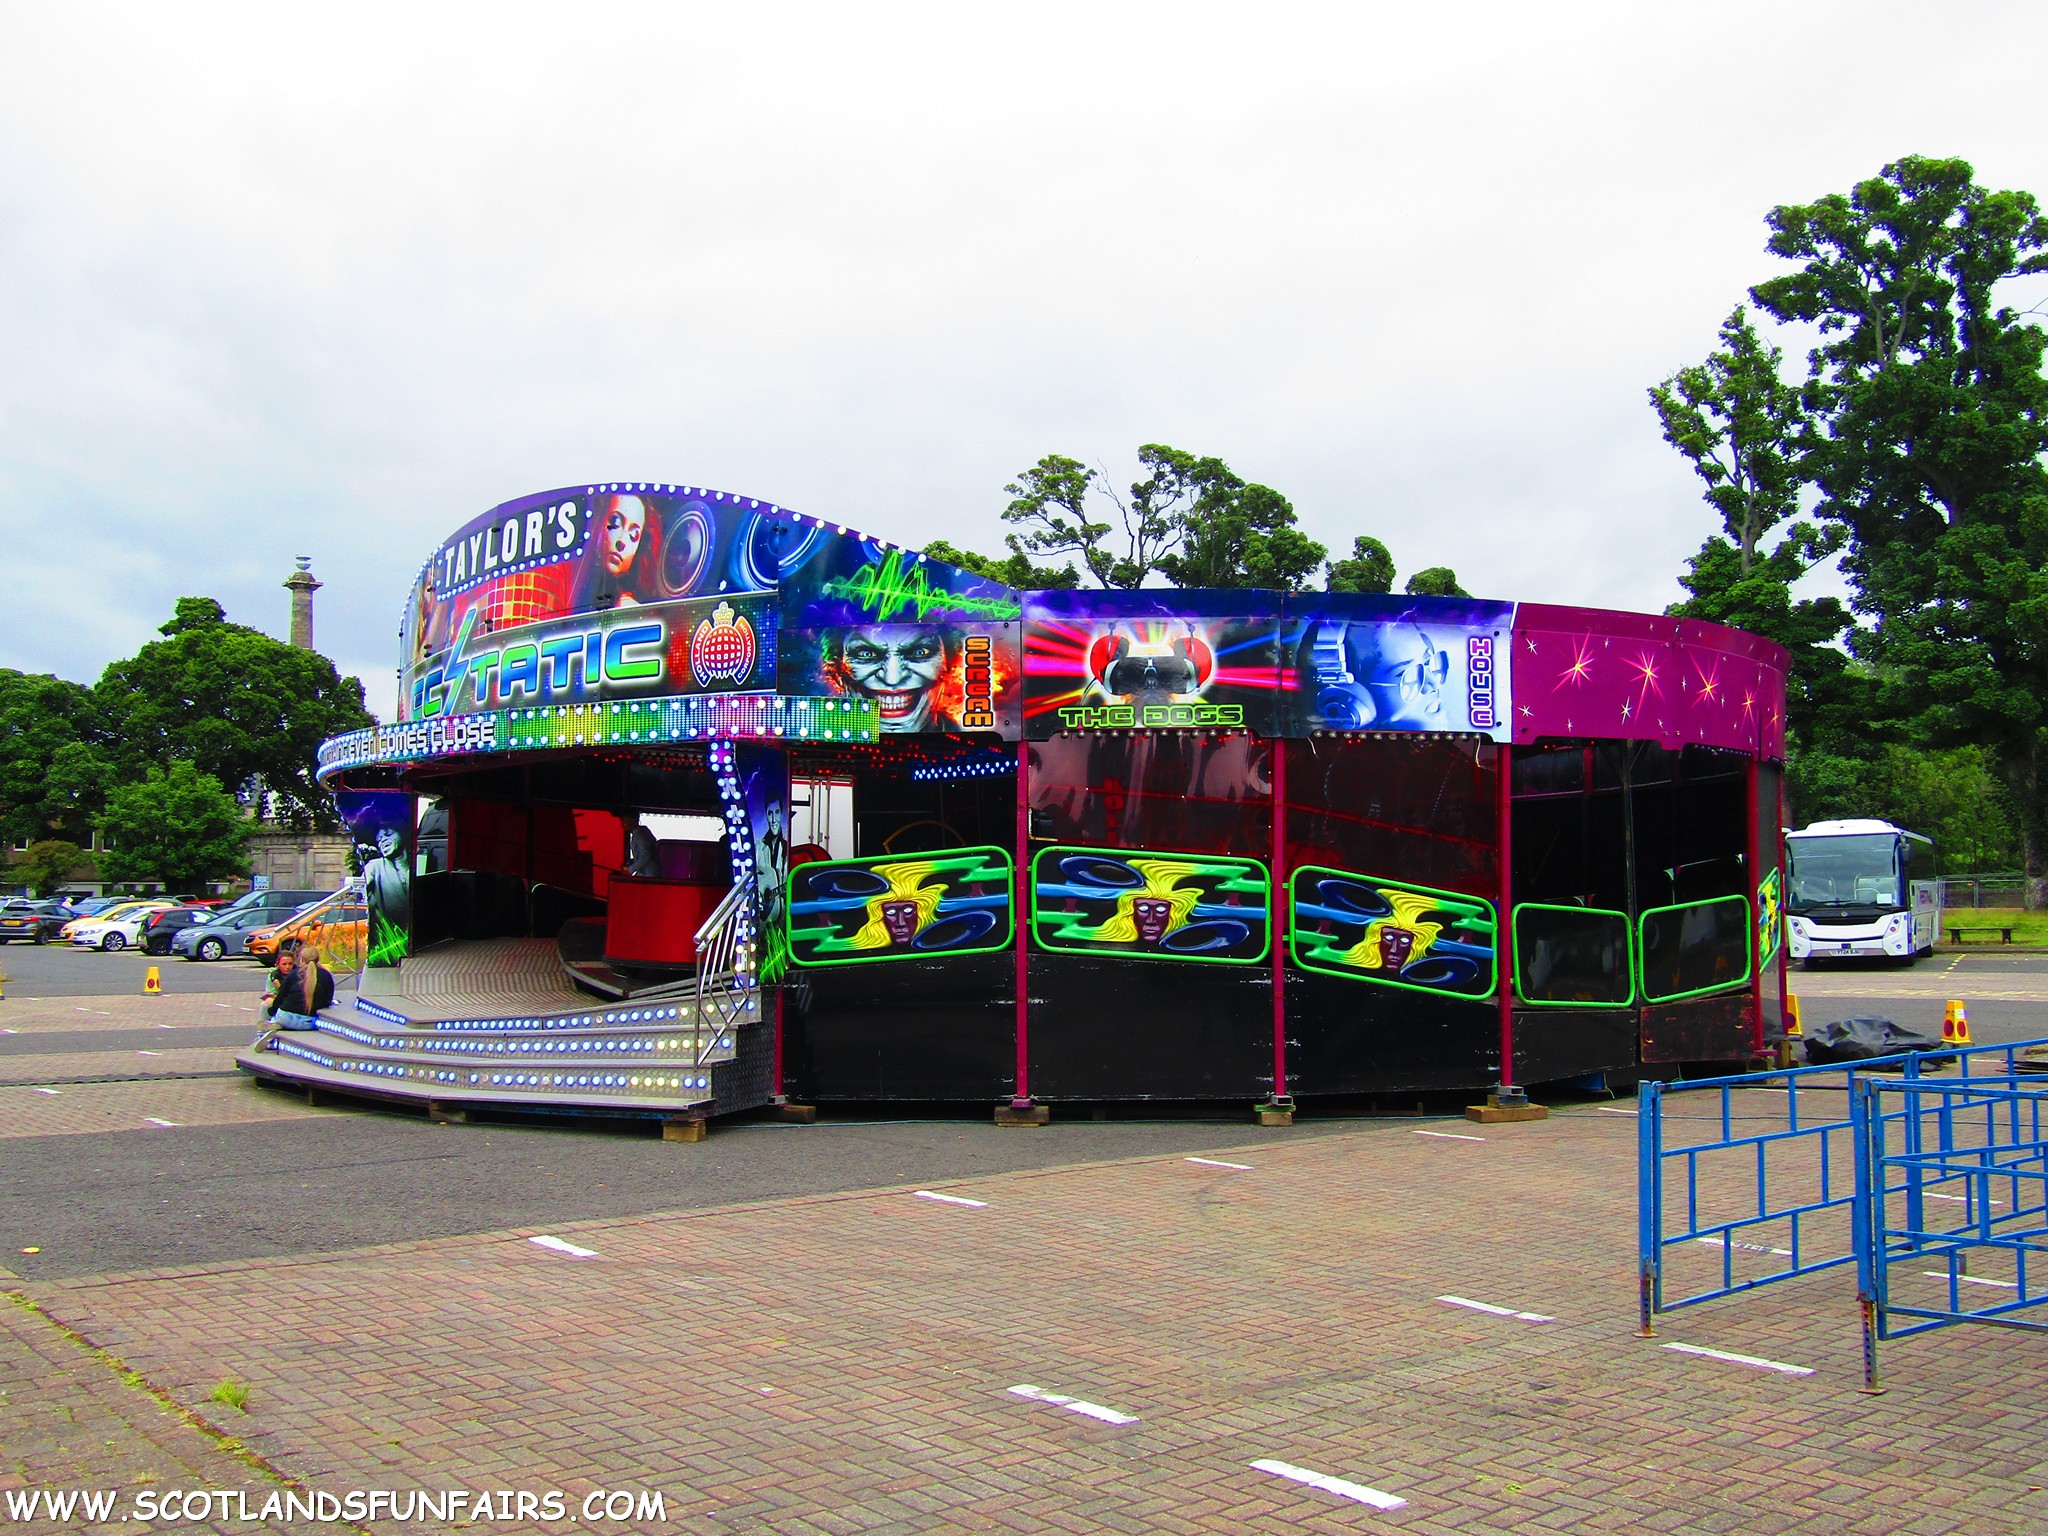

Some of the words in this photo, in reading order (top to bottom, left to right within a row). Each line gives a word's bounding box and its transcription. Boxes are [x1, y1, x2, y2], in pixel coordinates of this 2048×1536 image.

[445, 501, 577, 588] TAYLOR'S
[694, 625, 709, 682] HOLLAND
[737, 622, 752, 679] CORPORATION
[963, 636, 993, 727] SCREAM
[1469, 637, 1494, 727] HOUSE
[379, 728, 427, 754] COMES
[431, 721, 495, 746] CLOSE
[1058, 706, 1134, 728] THE
[1143, 704, 1243, 726] DOGS
